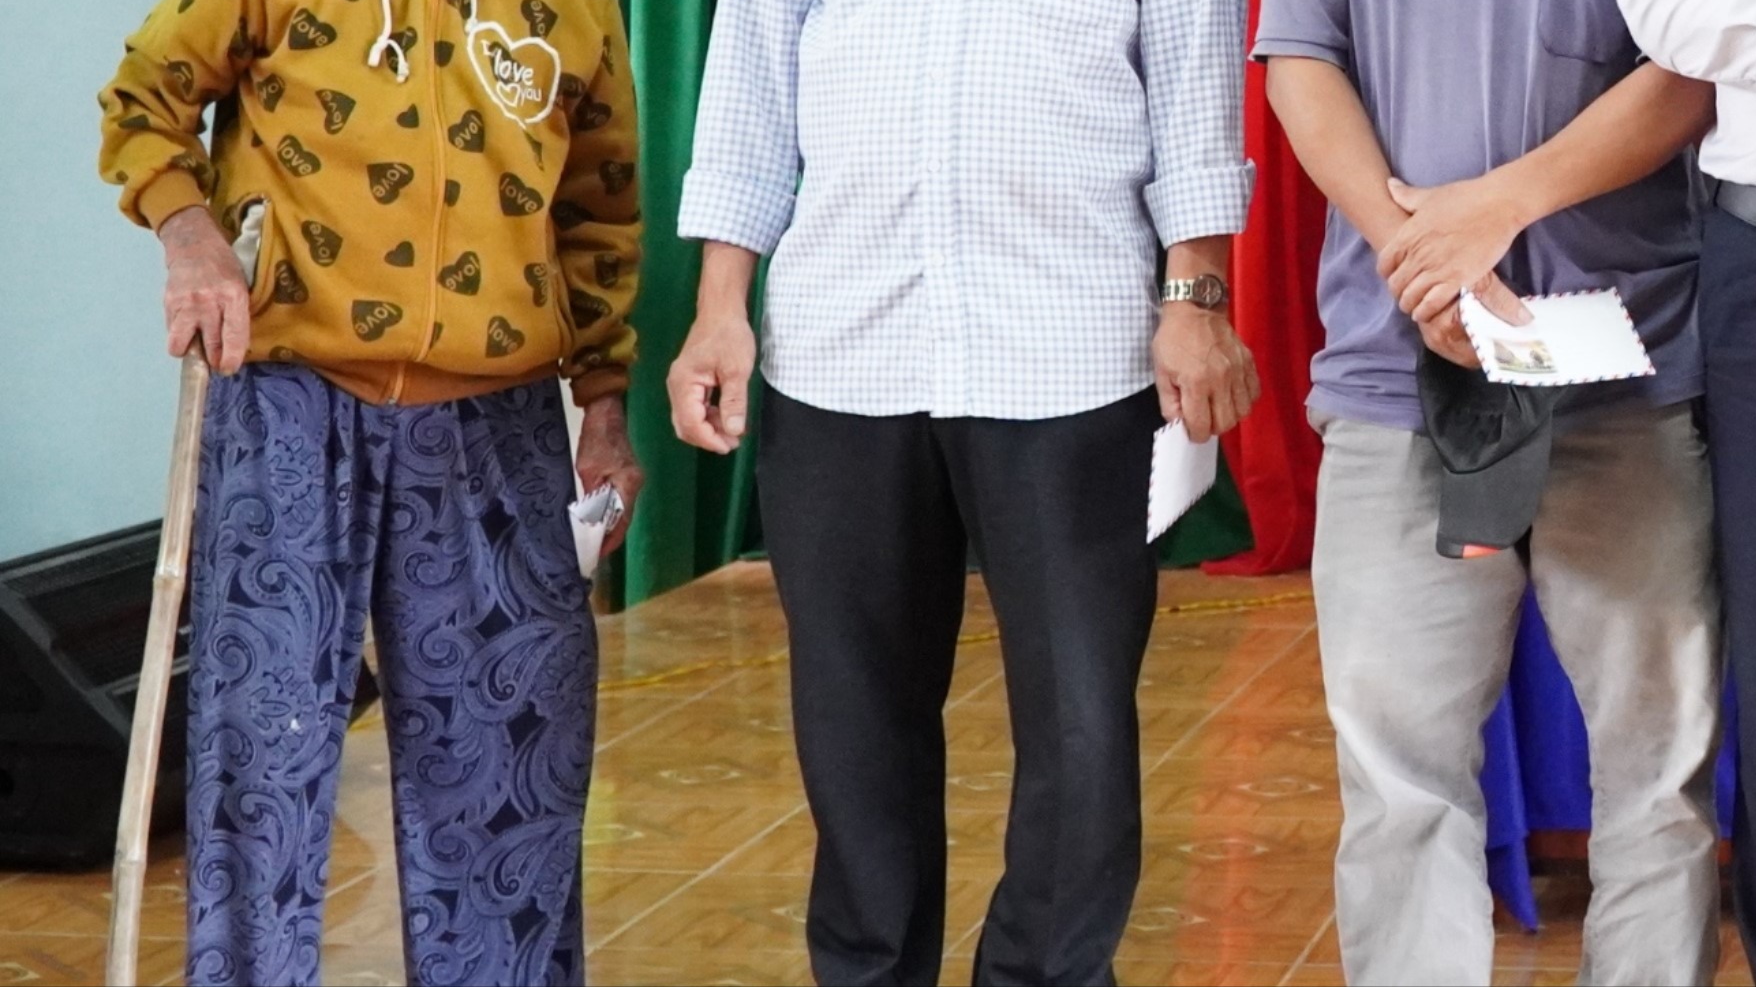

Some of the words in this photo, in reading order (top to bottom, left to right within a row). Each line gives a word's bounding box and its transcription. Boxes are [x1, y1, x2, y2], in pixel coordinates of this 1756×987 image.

[293, 14, 329, 46] love
[494, 47, 534, 86] love
[519, 85, 542, 106] you
[279, 139, 312, 175] love
[501, 177, 538, 212] love
[489, 320, 518, 354] love
